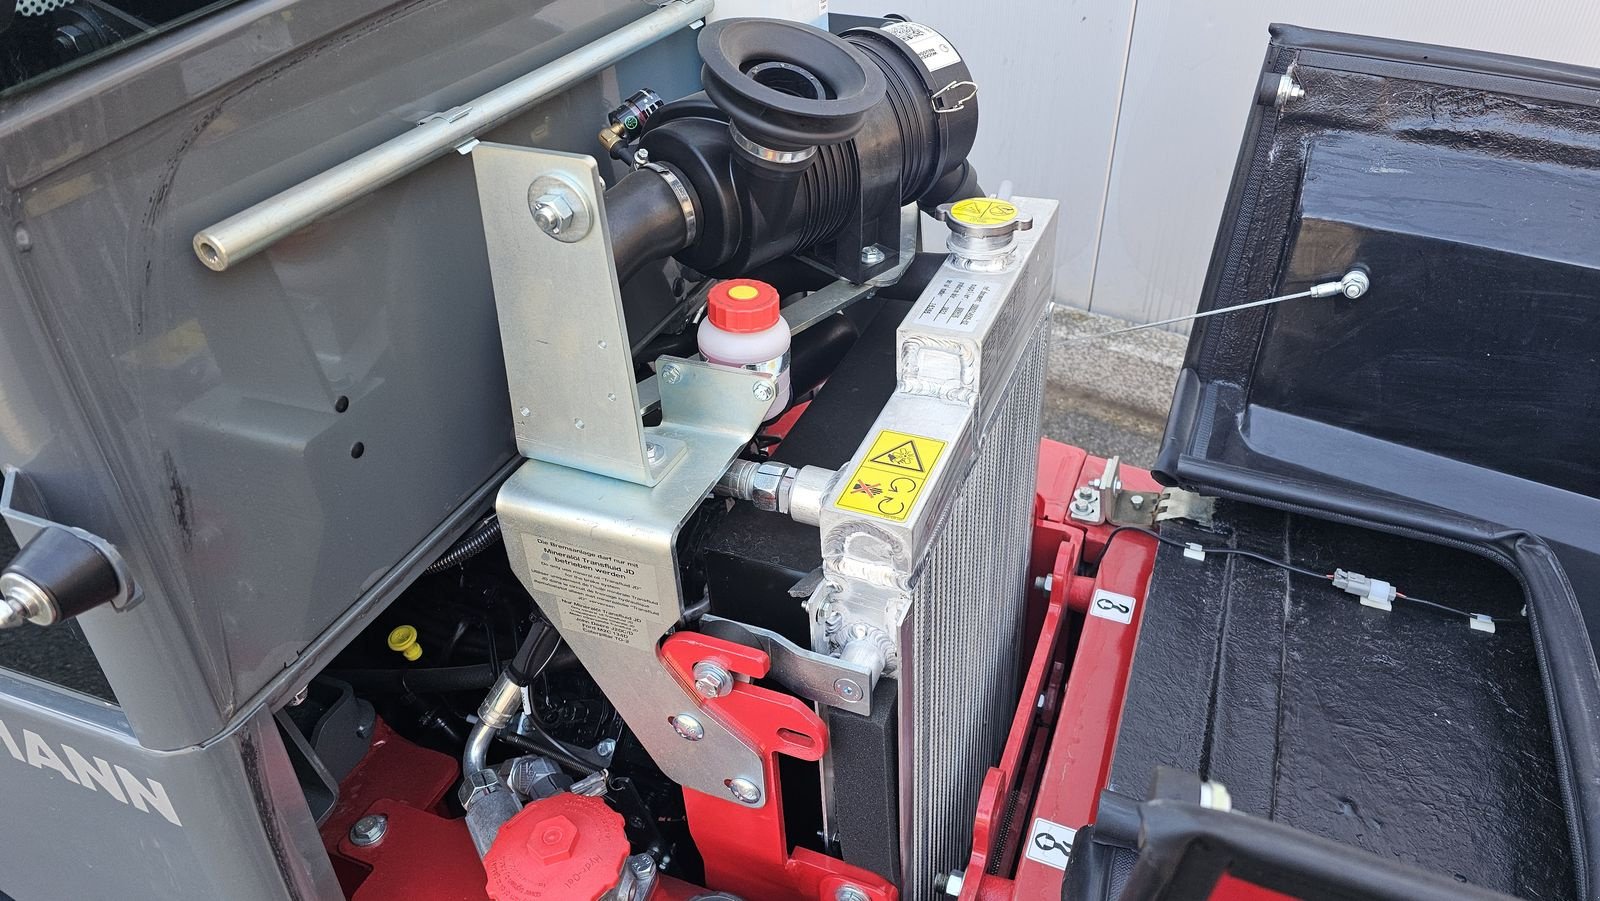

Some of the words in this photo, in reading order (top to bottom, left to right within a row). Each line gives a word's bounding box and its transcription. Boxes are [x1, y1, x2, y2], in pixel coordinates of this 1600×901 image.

[550, 542, 595, 558] Bremsanlage
[554, 557, 592, 570] betrieben
[594, 567, 625, 579] werden
[582, 557, 621, 571] Transfluid
